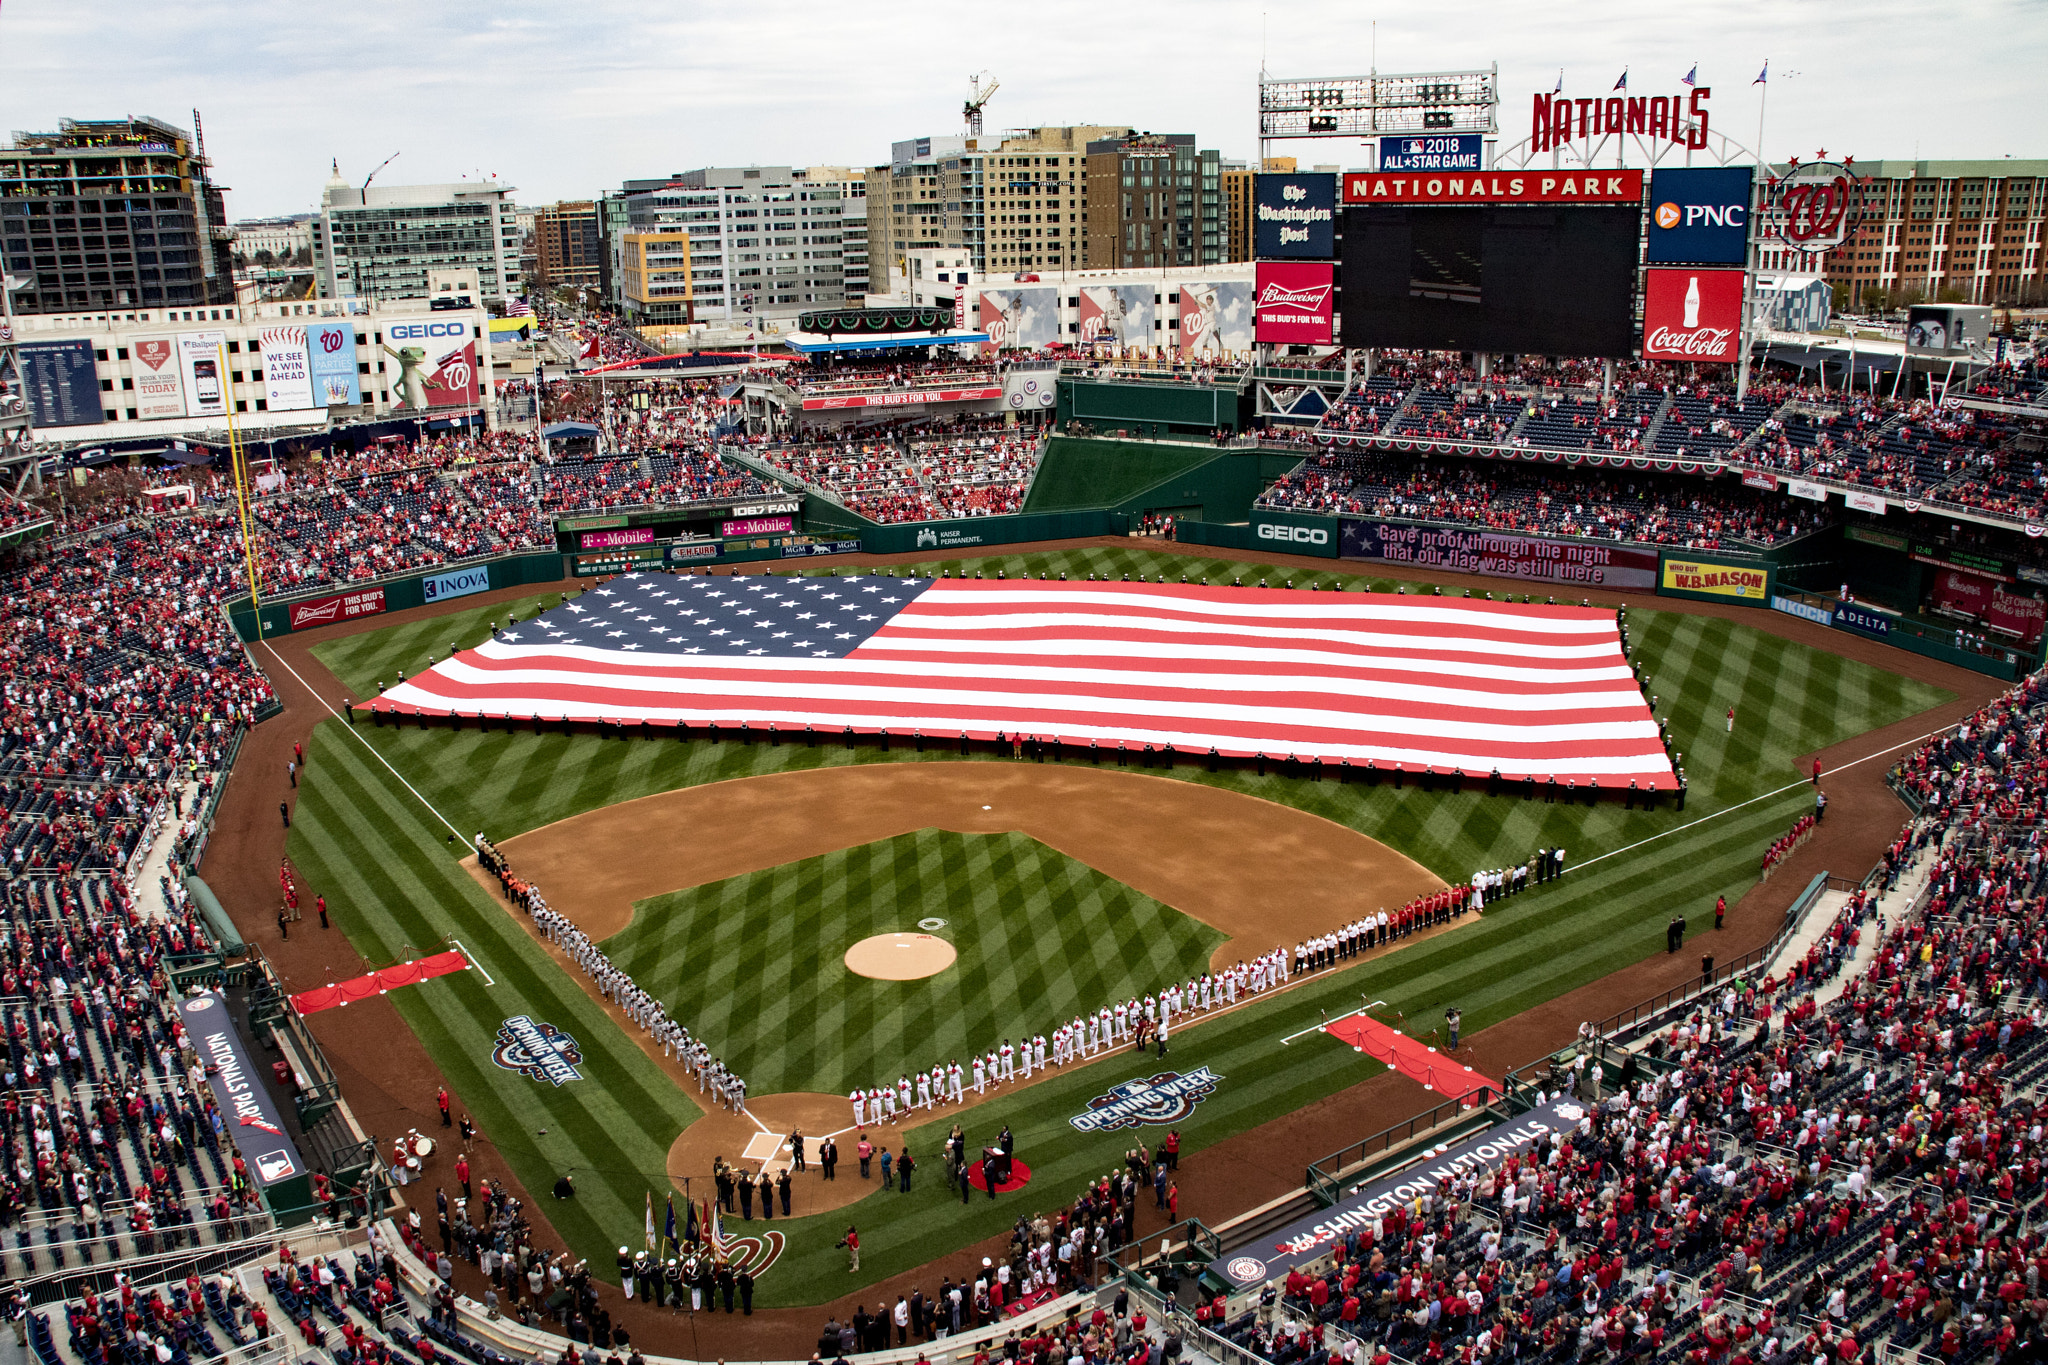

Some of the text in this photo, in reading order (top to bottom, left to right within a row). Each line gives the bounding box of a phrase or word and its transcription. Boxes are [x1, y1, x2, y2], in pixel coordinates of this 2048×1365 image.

[1531, 87, 1711, 152] NATIONALS
[1426, 138, 1459, 153] 2018
[1442, 153, 1477, 168] GAME
[1282, 185, 1307, 202] The
[1352, 177, 1623, 196] NATIONALS PARK
[1258, 203, 1332, 224] Washington
[1684, 205, 1744, 227] PNC
[1279, 226, 1309, 245] Post
[1262, 287, 1324, 303] Budweiser
[1261, 314, 1326, 324] THIS BUD'S FOR YOU.
[390, 322, 464, 340] GEICO
[1646, 326, 1734, 356] Coca-Cola
[267, 352, 303, 361] WE SEE
[314, 352, 351, 360] BIRTHDAY
[864, 347, 884, 355] LIGHT
[270, 362, 302, 371] A WIN
[315, 359, 353, 369] PARTIES
[270, 371, 305, 381] AHEAD
[140, 383, 177, 393] TODAY
[865, 396, 884, 405] THIS
[884, 394, 908, 404] BUD'S
[909, 393, 923, 403] FOR
[925, 392, 942, 402] YOU.
[1744, 478, 1773, 490] CHAMPIONS
[1796, 486, 1817, 498] CHAMPIONS
[768, 502, 799, 514] FAN
[1853, 498, 1876, 510] CHAMPIONS
[940, 530, 961, 538] KAISER
[1257, 523, 1328, 545] GEICO
[785, 546, 806, 554] MGM
[837, 541, 857, 549] MGM
[1379, 524, 1610, 566] Gave proof through the night
[1915, 545, 1932, 555] 12:48
[1383, 543, 1603, 583] that our flag was still there
[1669, 564, 1698, 573] WHO BUT
[1914, 555, 1940, 566] WASHINGTON
[1941, 561, 1963, 572] NATIONALS
[1964, 566, 1979, 575] DREAM
[1980, 569, 2007, 581] FOUNDATION
[440, 572, 488, 594] INOVA
[344, 590, 384, 607] THIS BUD'S
[299, 605, 337, 621] Budweiser
[344, 600, 378, 616] FOR YOU.
[1787, 600, 1828, 624] KOCH
[1848, 612, 1887, 632] DELTA
[505, 1016, 554, 1057] OPENING
[204, 1032, 249, 1094] NATIONALS
[539, 1052, 578, 1084] WEEK
[1072, 1068, 1219, 1131] OPENING WEEK
[1285, 1120, 1550, 1256] WASHINGTON NATIONALS
